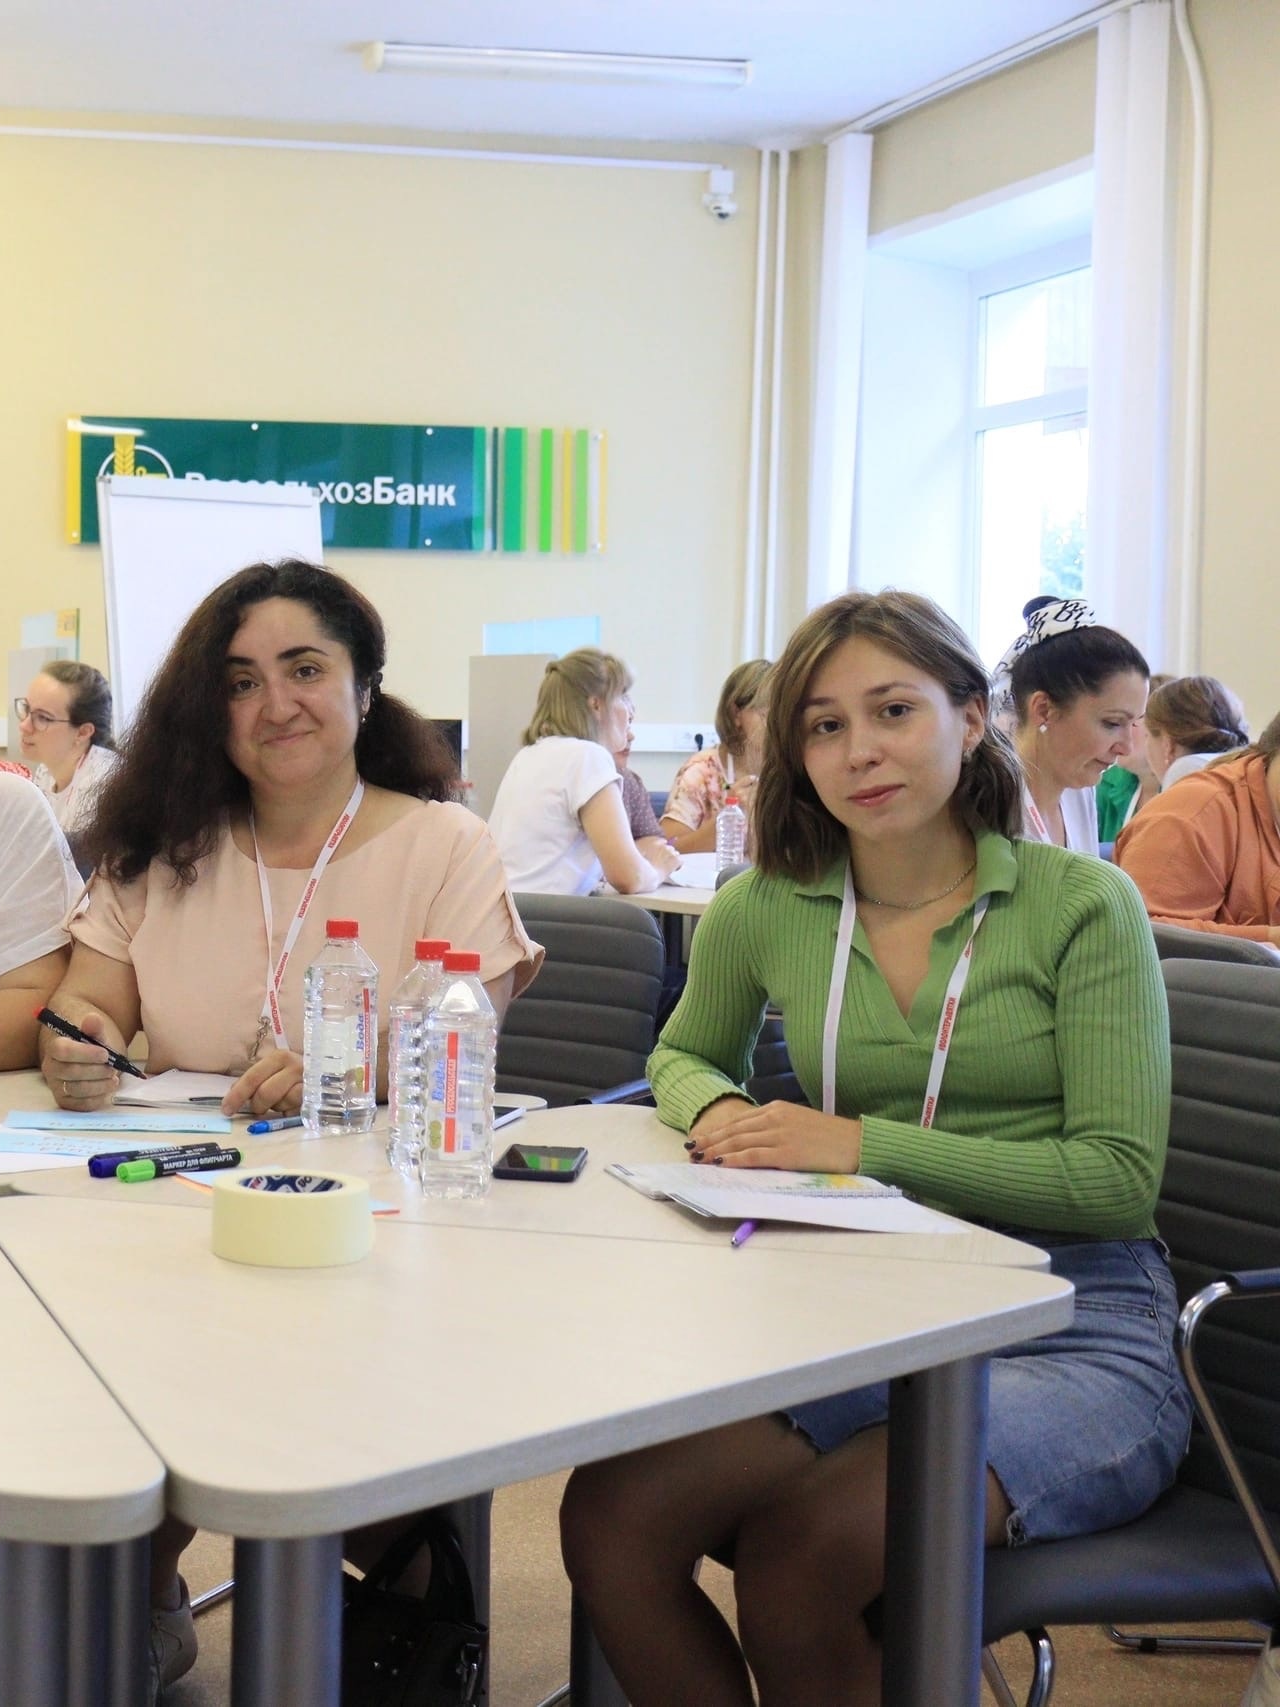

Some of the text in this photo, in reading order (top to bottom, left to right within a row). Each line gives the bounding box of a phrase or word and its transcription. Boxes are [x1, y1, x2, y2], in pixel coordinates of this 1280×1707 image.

[185, 472, 457, 507] хозБанк
[163, 1153, 234, 1170] МАРКЕР ДЛЯ ФЛИПЧАРТА
